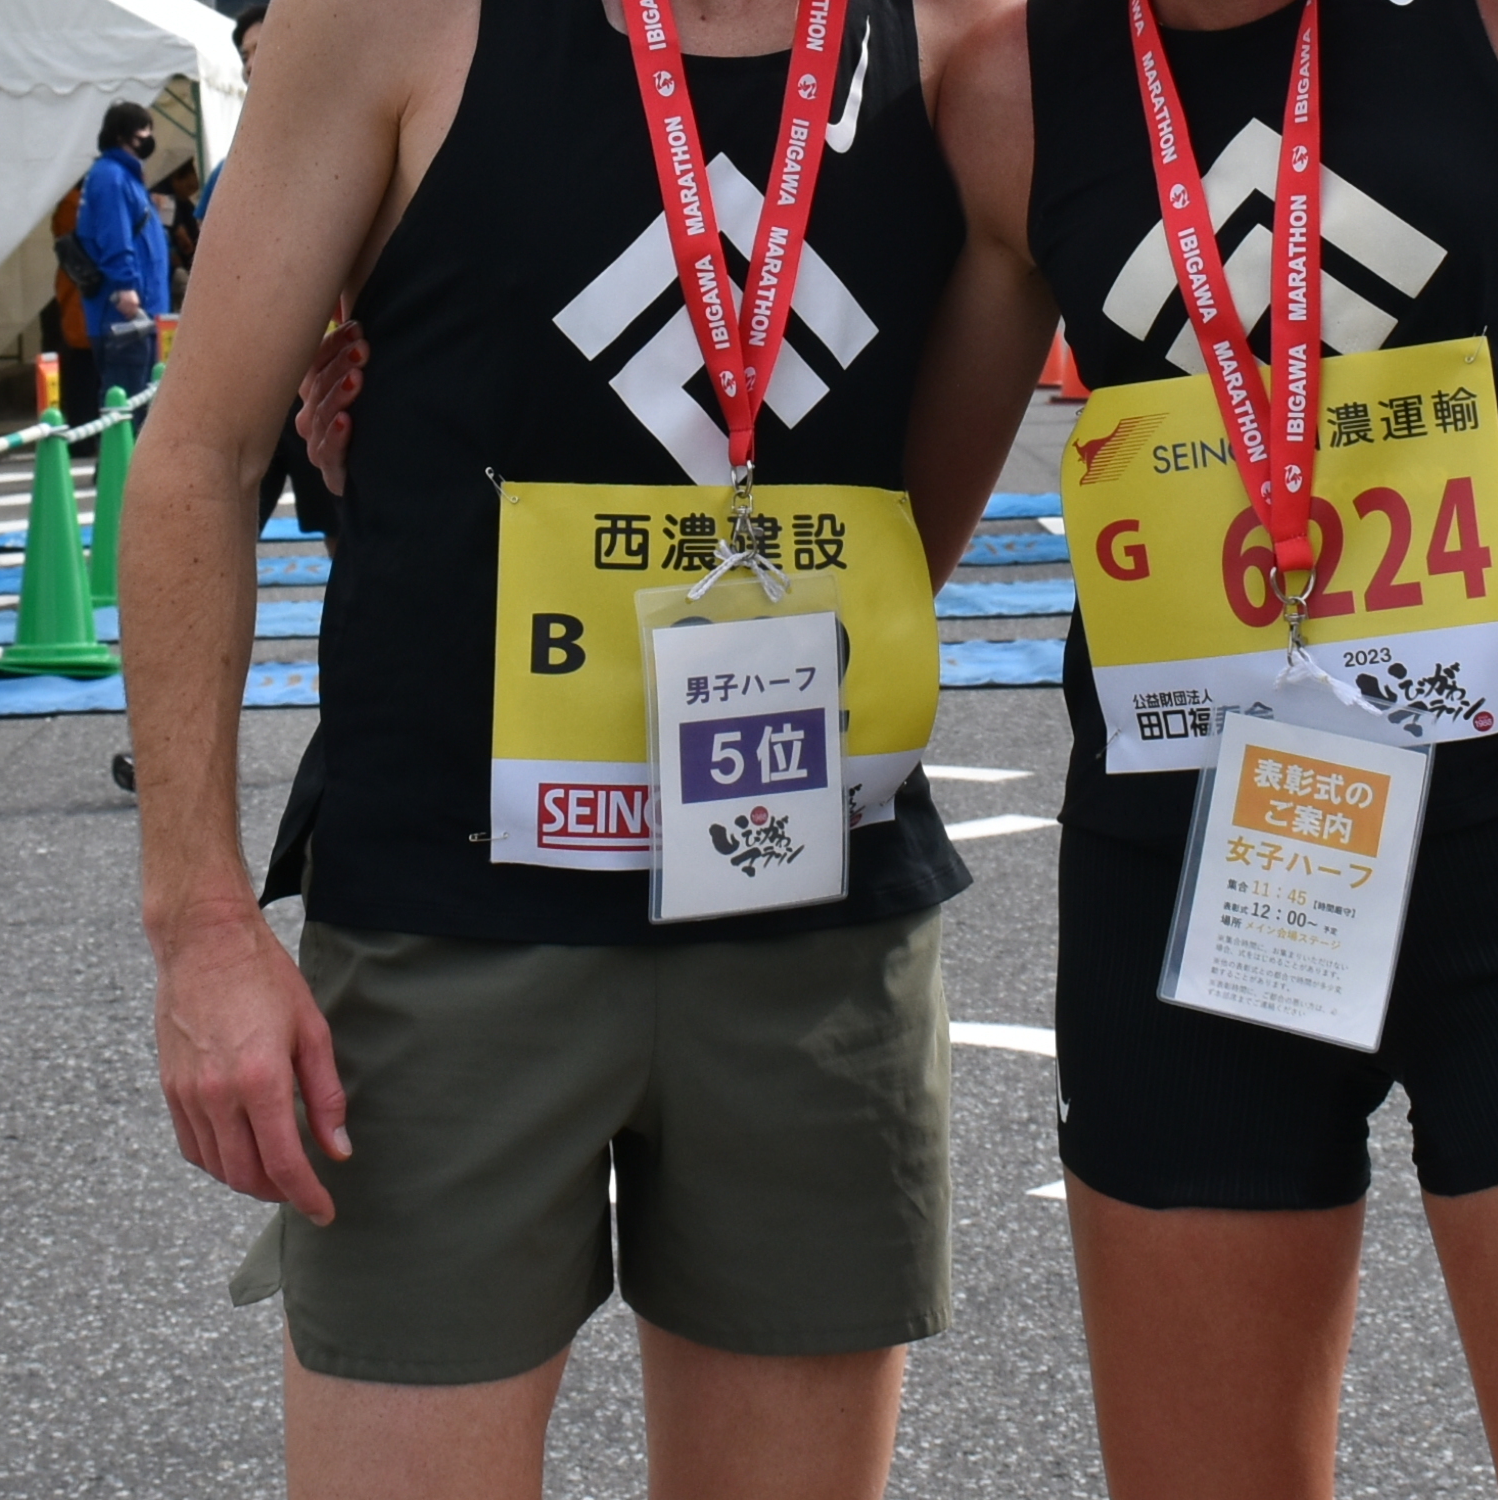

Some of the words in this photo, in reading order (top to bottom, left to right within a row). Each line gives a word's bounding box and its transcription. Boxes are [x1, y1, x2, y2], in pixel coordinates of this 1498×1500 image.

[1294, 27, 1311, 123] IBIGAWA
[1142, 51, 1177, 165] MARATHON
[664, 115, 705, 236] MARATHON
[777, 118, 810, 206] IBIGAWA
[748, 226, 789, 347] MARATHON
[1288, 194, 1307, 321] MARATHON
[695, 254, 730, 350] IBIGAWA
[1177, 227, 1218, 324] IBIGAWA
[1213, 340, 1268, 463] MARATHON
[1286, 344, 1307, 442] IBIGAWA
[1315, 386, 1481, 451] 濃運輸
[594, 512, 848, 572] 西濃建設
[1095, 518, 1151, 582] G
[1221, 475, 1493, 628] 6224
[530, 613, 587, 676] B
[1343, 648, 1392, 668] 2023
[685, 666, 817, 706] 男子ハーフ
[1132, 687, 1213, 710] 公益財団法人
[709, 723, 809, 785] 5位
[1253, 757, 1374, 809] 表彰式の
[1264, 798, 1353, 845] ご案内
[1225, 835, 1374, 889] 女子ハーフ
[1227, 878, 1249, 893] 集合
[1221, 914, 1242, 929] 場所
[1245, 921, 1342, 950] メイン会場ステージ
[1223, 901, 1249, 915] 表彰式
